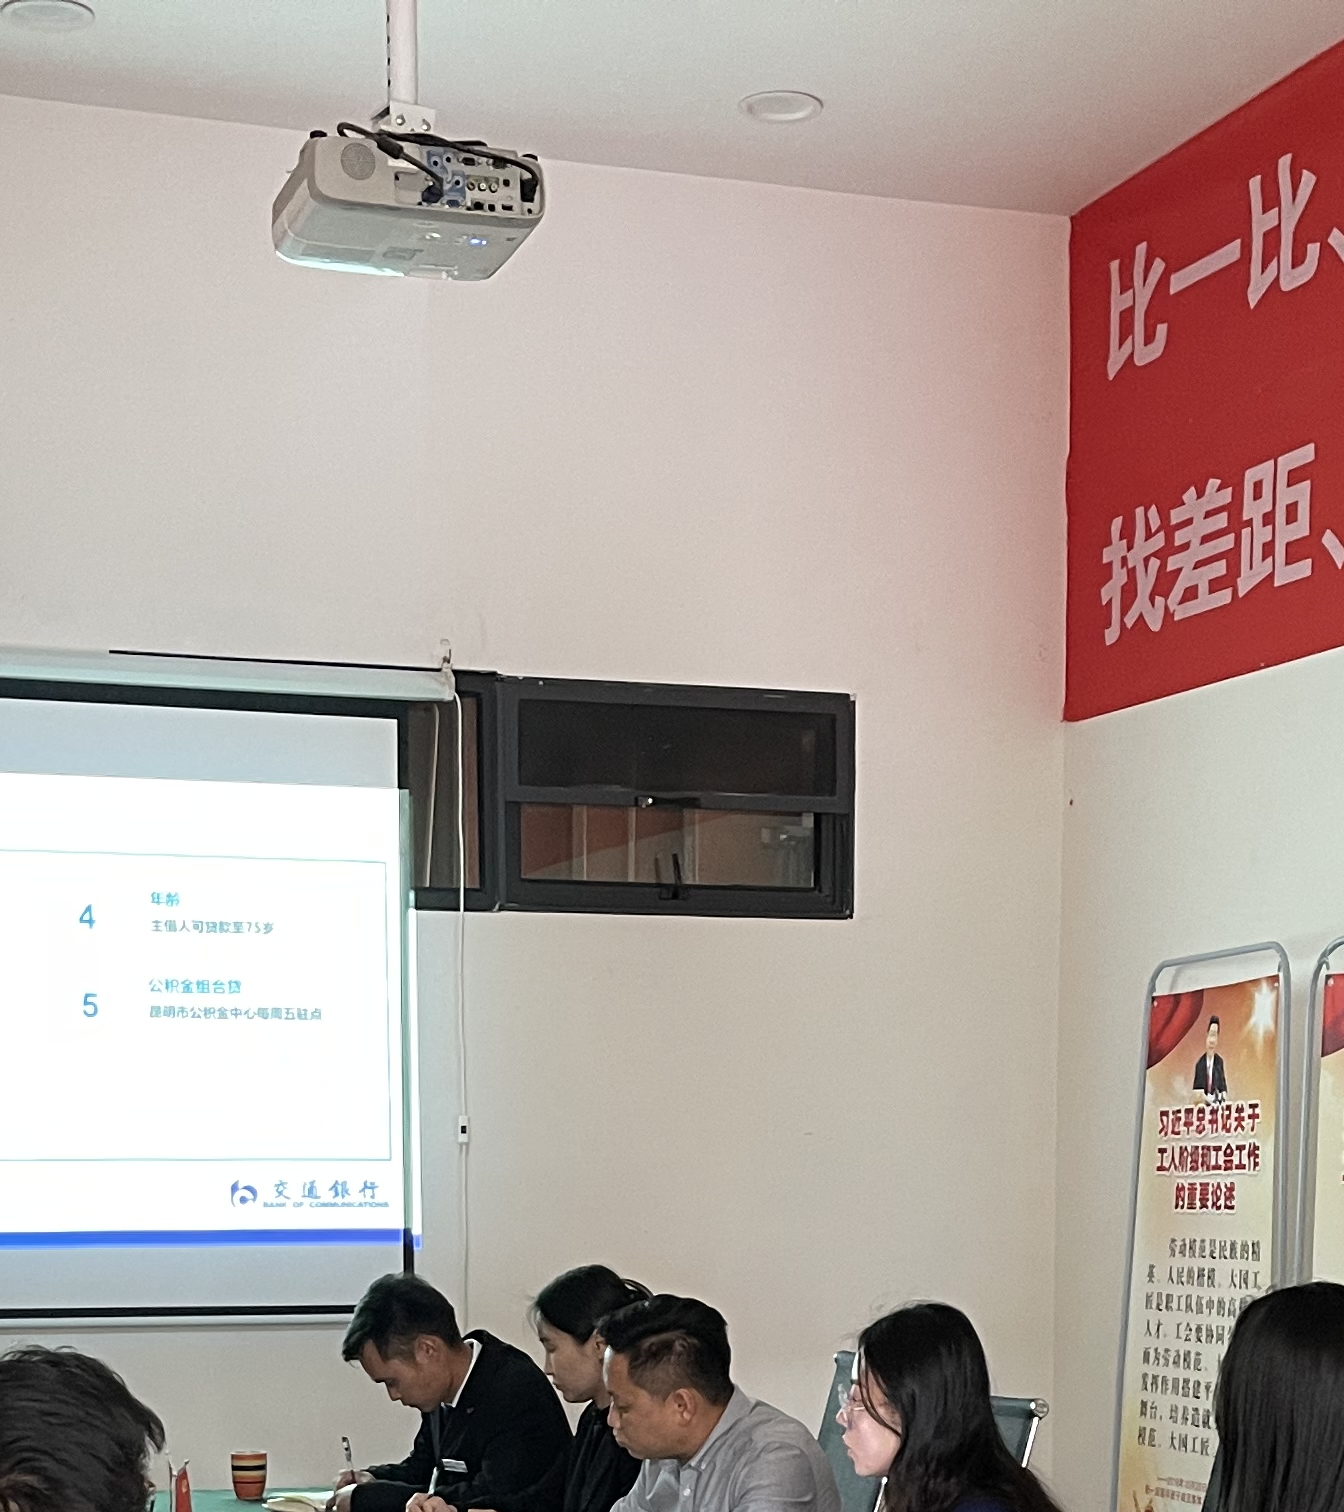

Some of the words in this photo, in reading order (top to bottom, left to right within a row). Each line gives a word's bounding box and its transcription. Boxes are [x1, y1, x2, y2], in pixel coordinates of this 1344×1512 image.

[150, 891, 181, 907] 年龄
[79, 904, 96, 929] 4
[148, 978, 242, 995] 公积金组合贷
[82, 993, 99, 1018] 5
[1158, 1102, 1260, 1138] 习近平总书记关于
[1156, 1141, 1260, 1173] 工人阶级和工会工作
[1174, 1182, 1236, 1211] 的重要论述
